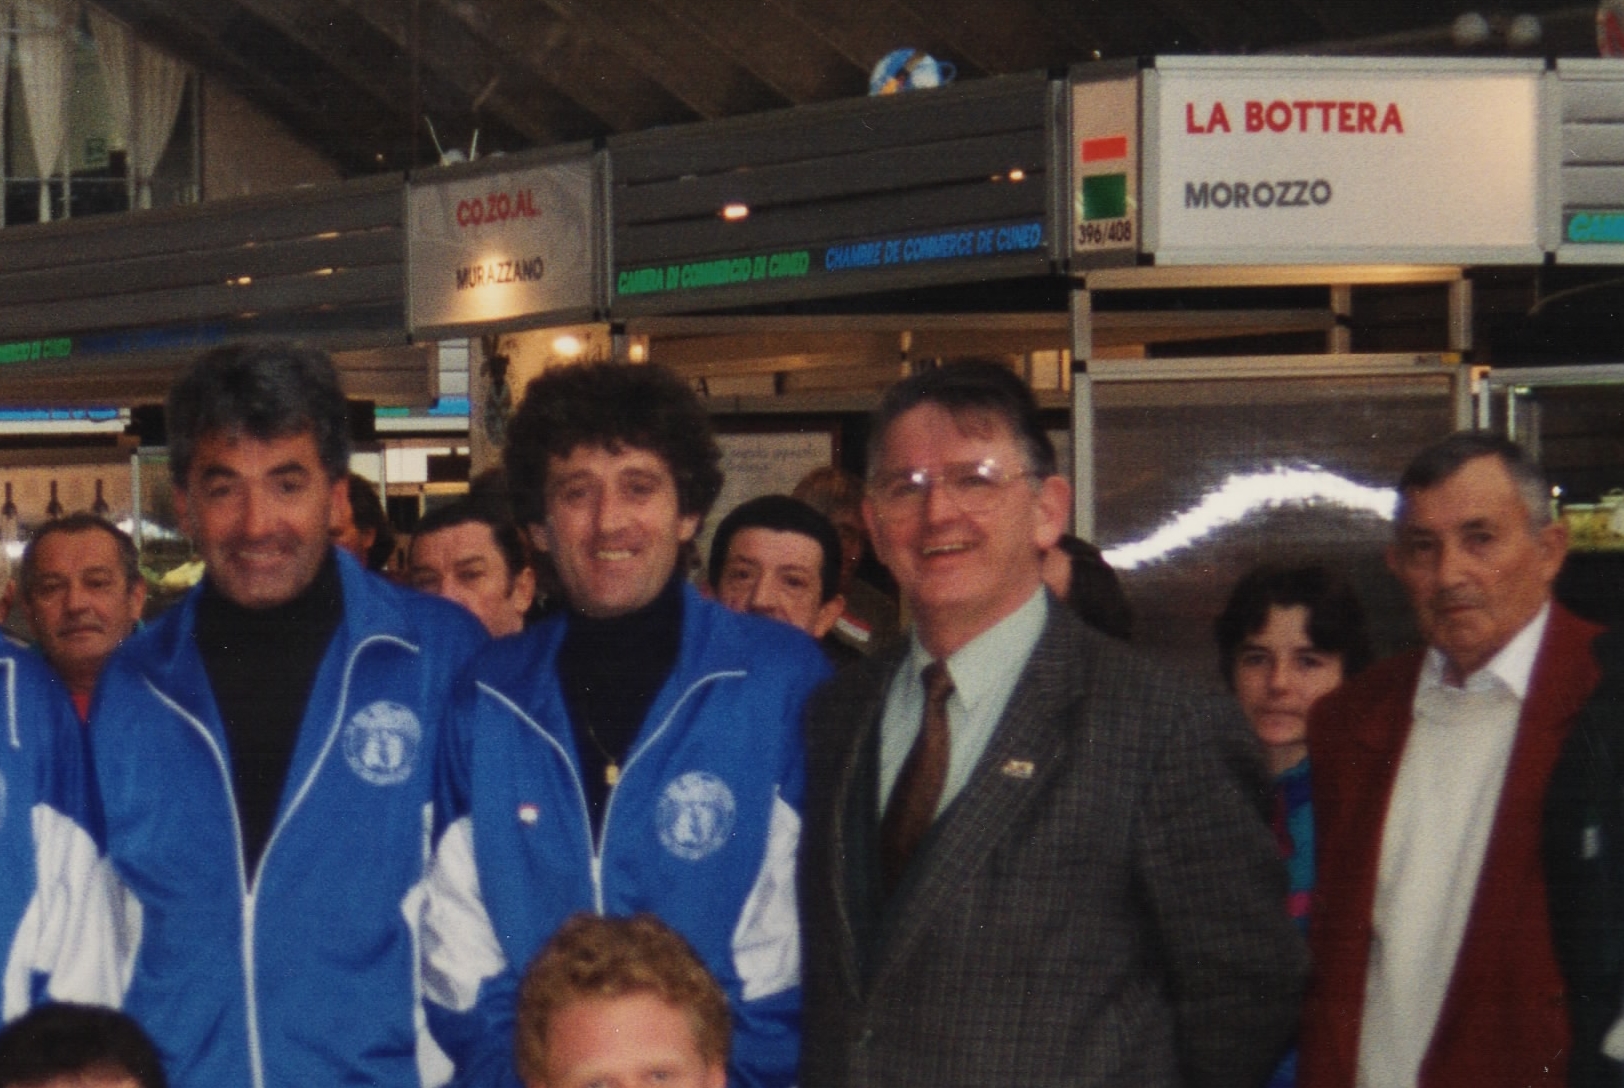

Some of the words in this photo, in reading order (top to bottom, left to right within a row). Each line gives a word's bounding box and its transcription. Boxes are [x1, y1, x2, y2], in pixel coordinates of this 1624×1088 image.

[1186, 102, 1231, 134] LA
[1245, 101, 1404, 133] BOTTERA
[1185, 179, 1333, 210] MOROZZO
[884, 239, 902, 264] DE
[903, 229, 975, 262] COMMERCE
[976, 228, 995, 254] DE
[996, 221, 1043, 250] CUNEO
[1078, 219, 1132, 246] 396/408
[456, 256, 544, 290] MURAZZANO
